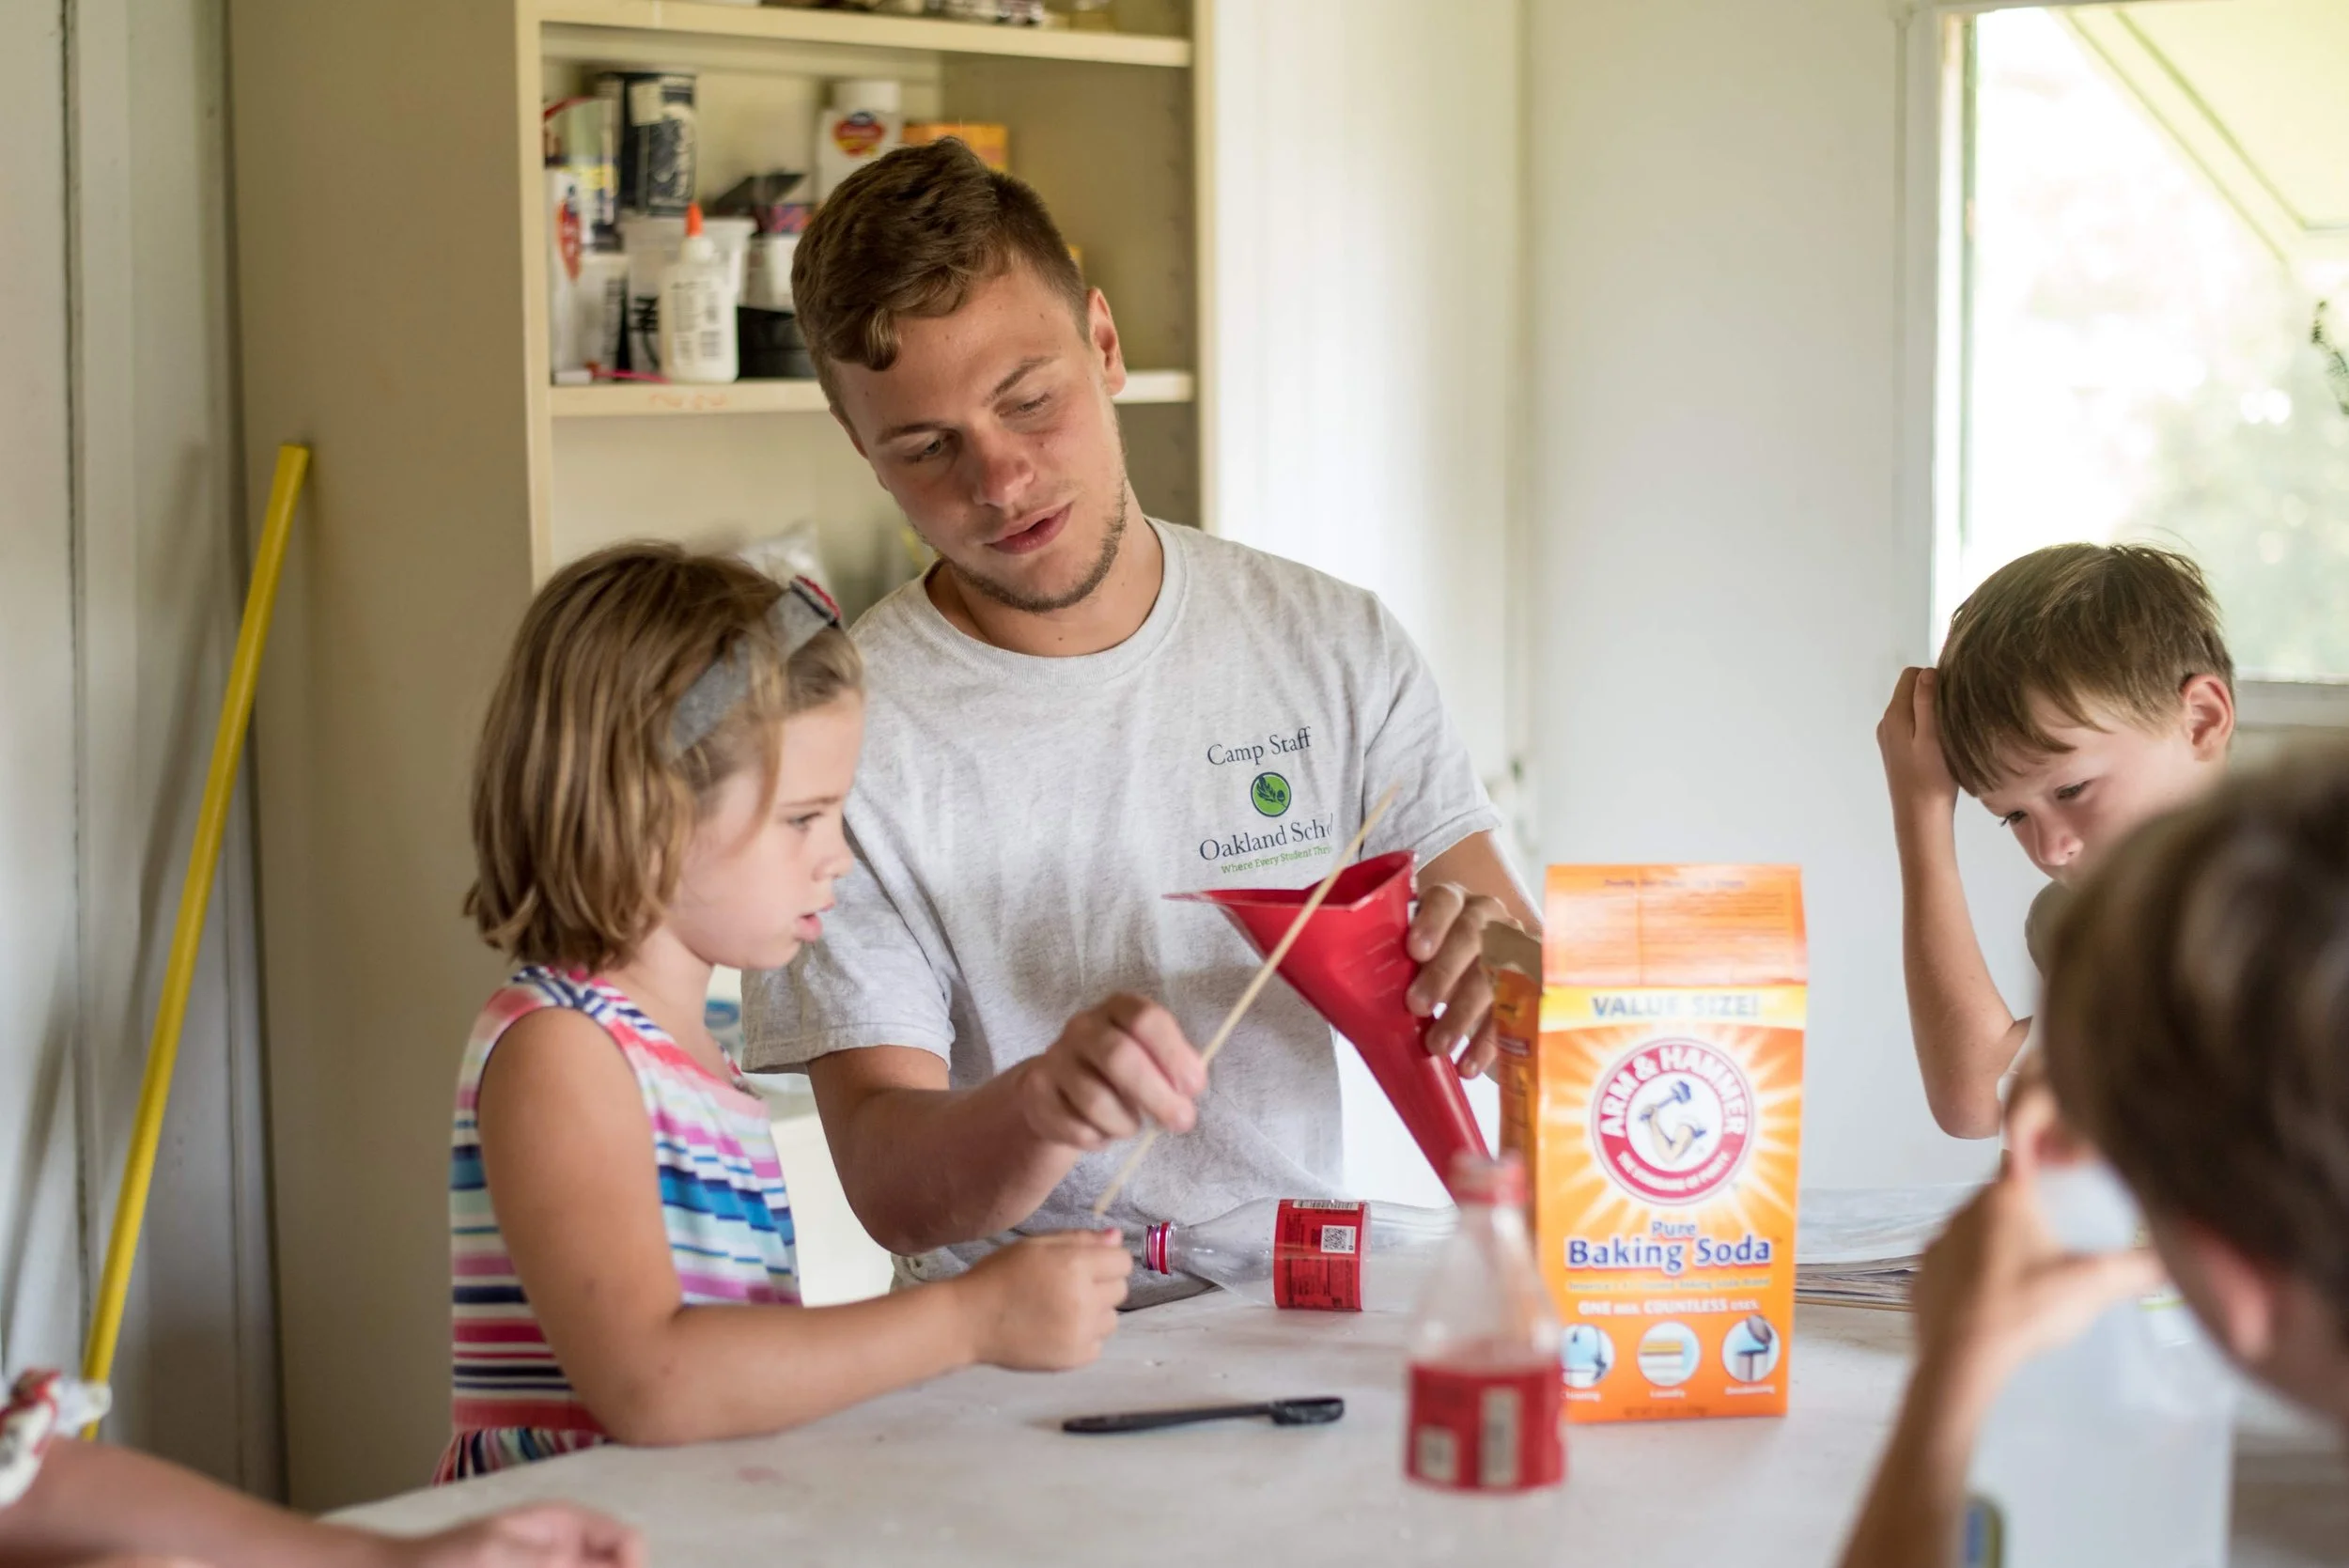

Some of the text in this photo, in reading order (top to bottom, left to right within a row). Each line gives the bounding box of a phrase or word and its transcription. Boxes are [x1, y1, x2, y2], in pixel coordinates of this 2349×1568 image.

[1207, 726, 1312, 766] Camp Staff
[1199, 825, 1288, 862] Oakland
[1221, 861, 1253, 875] Where
[1255, 853, 1280, 869] Every
[1280, 848, 1313, 862] Student
[1599, 1045, 1749, 1139] ARM & HAMMER
[1652, 1220, 1697, 1237] Pure
[1569, 1234, 1770, 1272] Baking Soda
